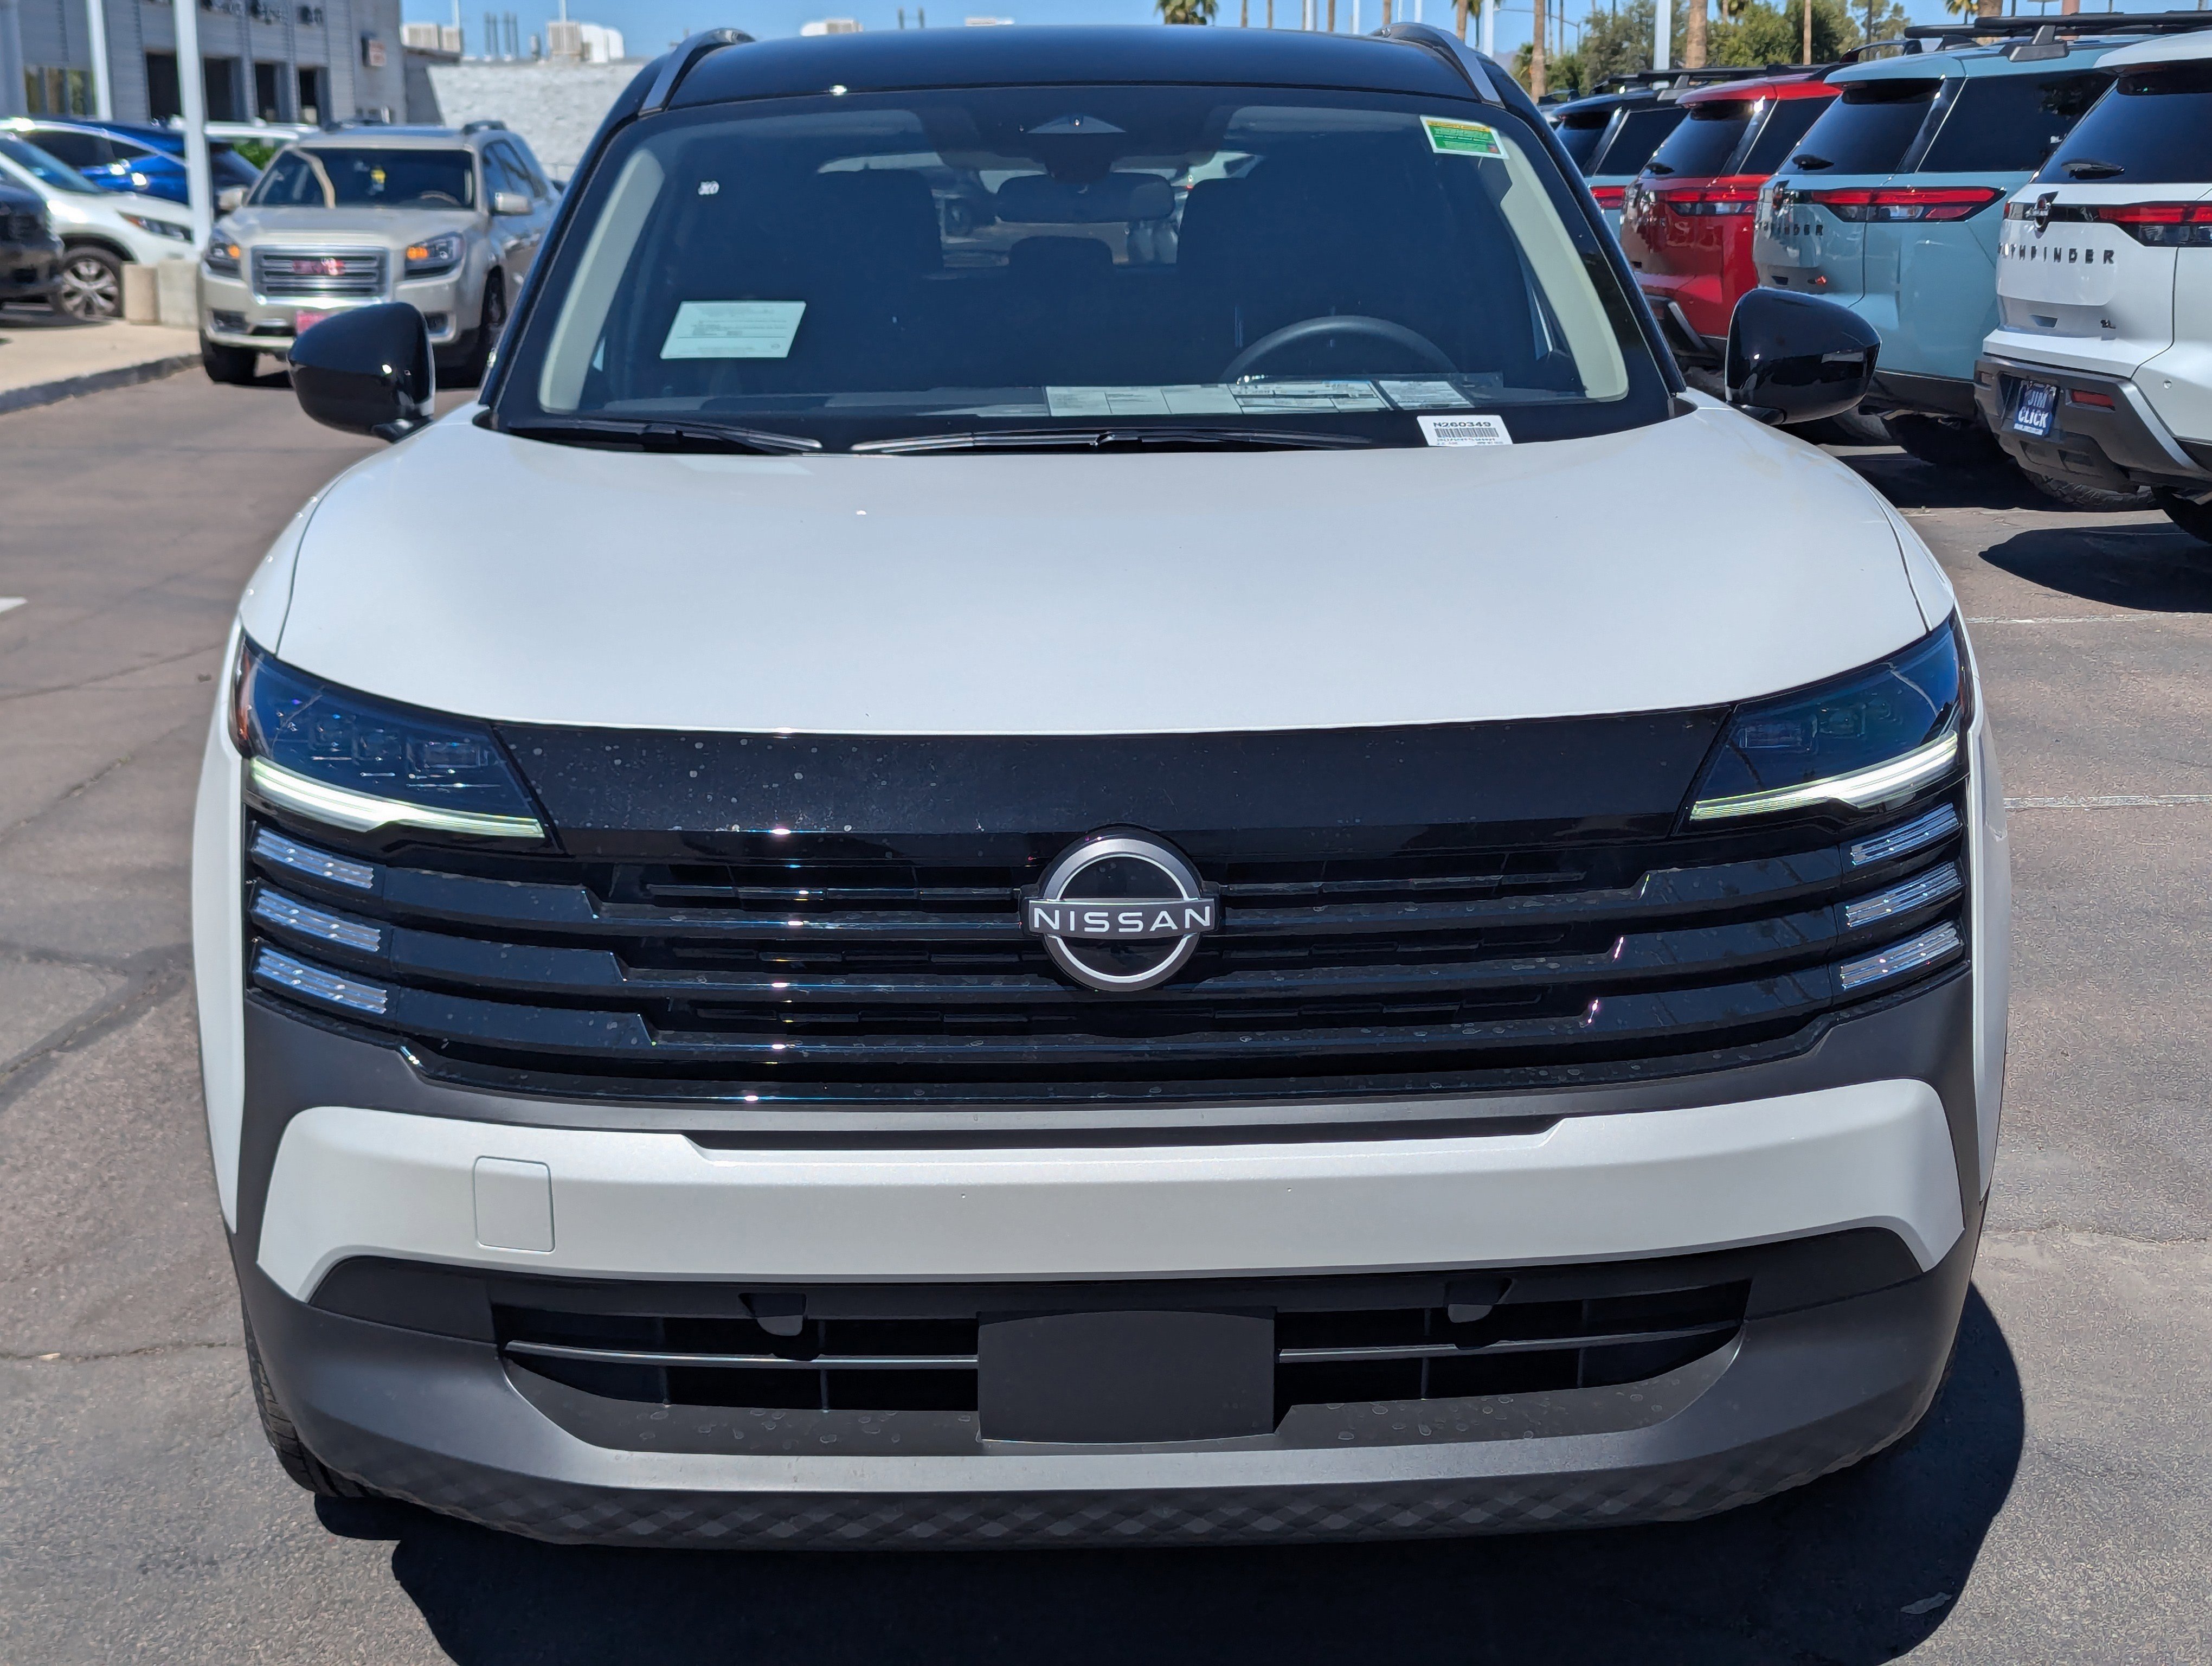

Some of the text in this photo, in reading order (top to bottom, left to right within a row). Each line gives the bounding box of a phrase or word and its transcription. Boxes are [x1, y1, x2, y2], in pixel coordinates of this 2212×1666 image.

[2028, 390, 2048, 409] JIM
[2018, 406, 2049, 428] CLICK
[1033, 906, 1211, 933] NISSAN
